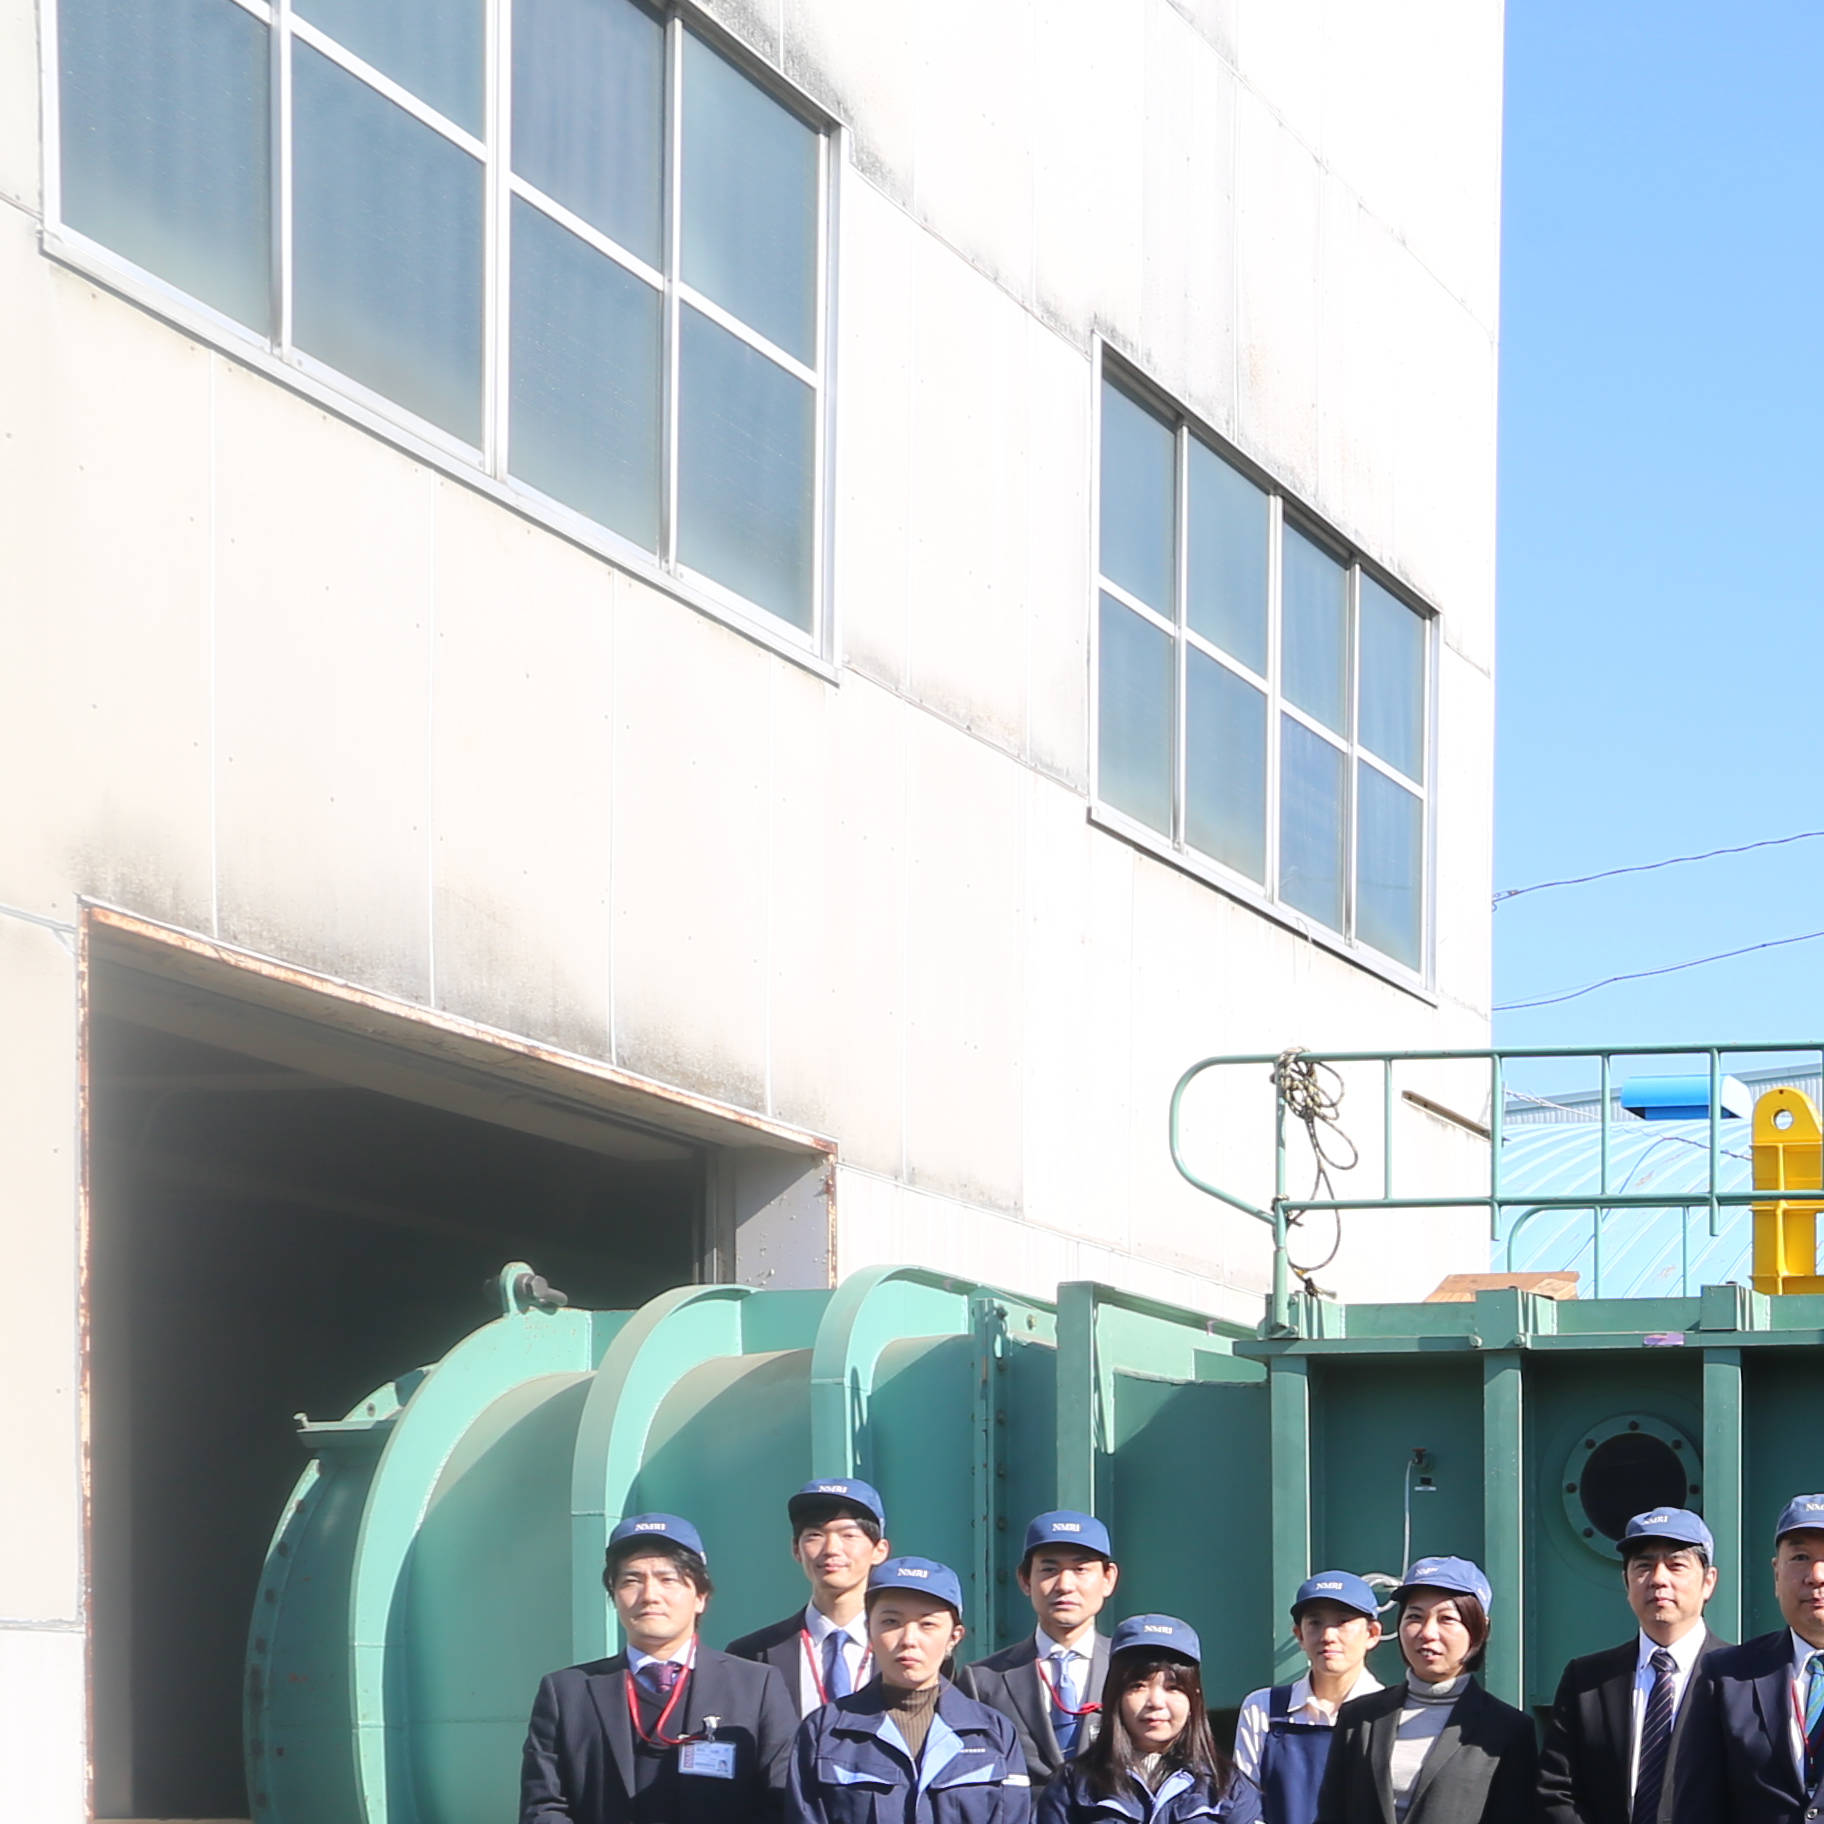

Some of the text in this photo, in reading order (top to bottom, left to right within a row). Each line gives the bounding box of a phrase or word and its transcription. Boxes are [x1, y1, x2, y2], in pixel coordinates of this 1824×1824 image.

[818, 1485, 848, 1494] NMRI
[635, 1523, 666, 1532] NMRI
[1052, 1523, 1080, 1532] NMRI
[897, 1568, 929, 1578] NMRI
[1316, 1582, 1343, 1591] NMRI
[1144, 1625, 1173, 1635] NMRI
